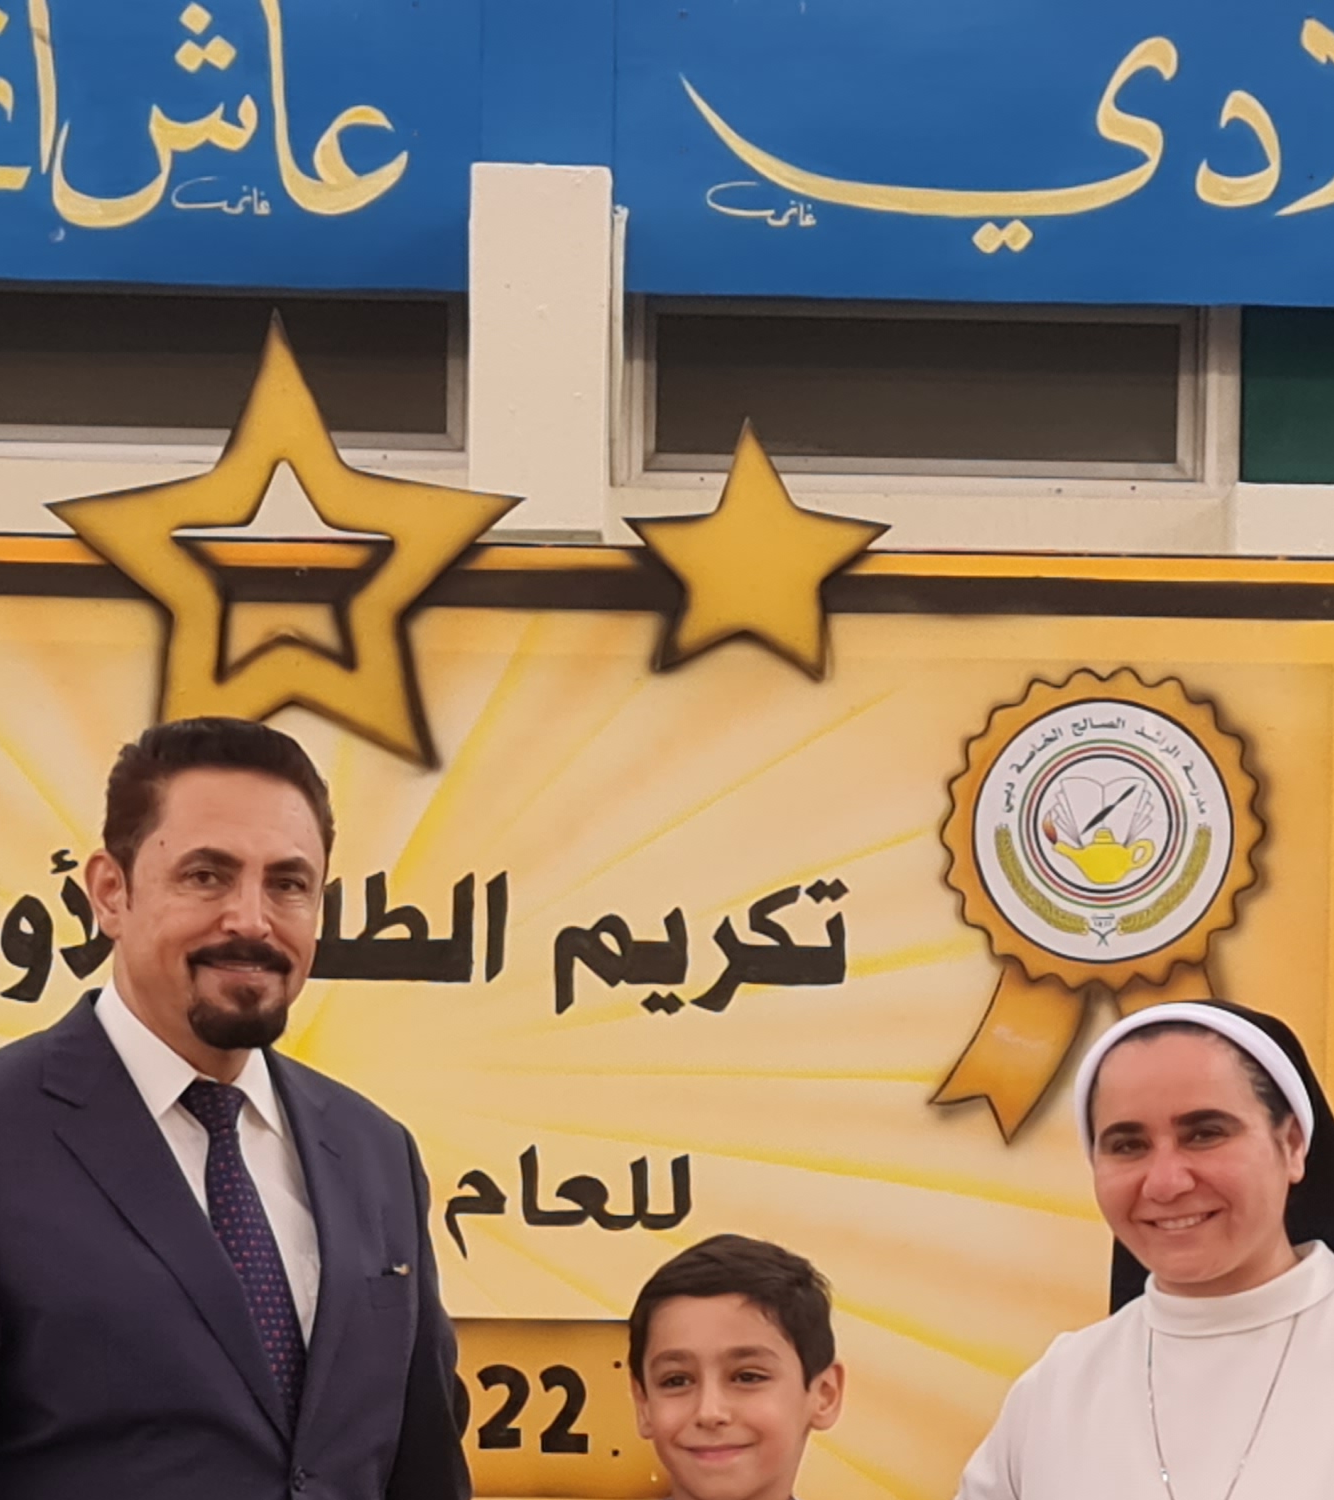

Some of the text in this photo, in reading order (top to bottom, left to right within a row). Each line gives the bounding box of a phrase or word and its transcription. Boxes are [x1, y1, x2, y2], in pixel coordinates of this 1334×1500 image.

[53, 0, 409, 228] عاش
[1071, 717, 1126, 737] الصالح
[554, 878, 850, 1016] تكريم
[444, 1144, 692, 1261] للعام
